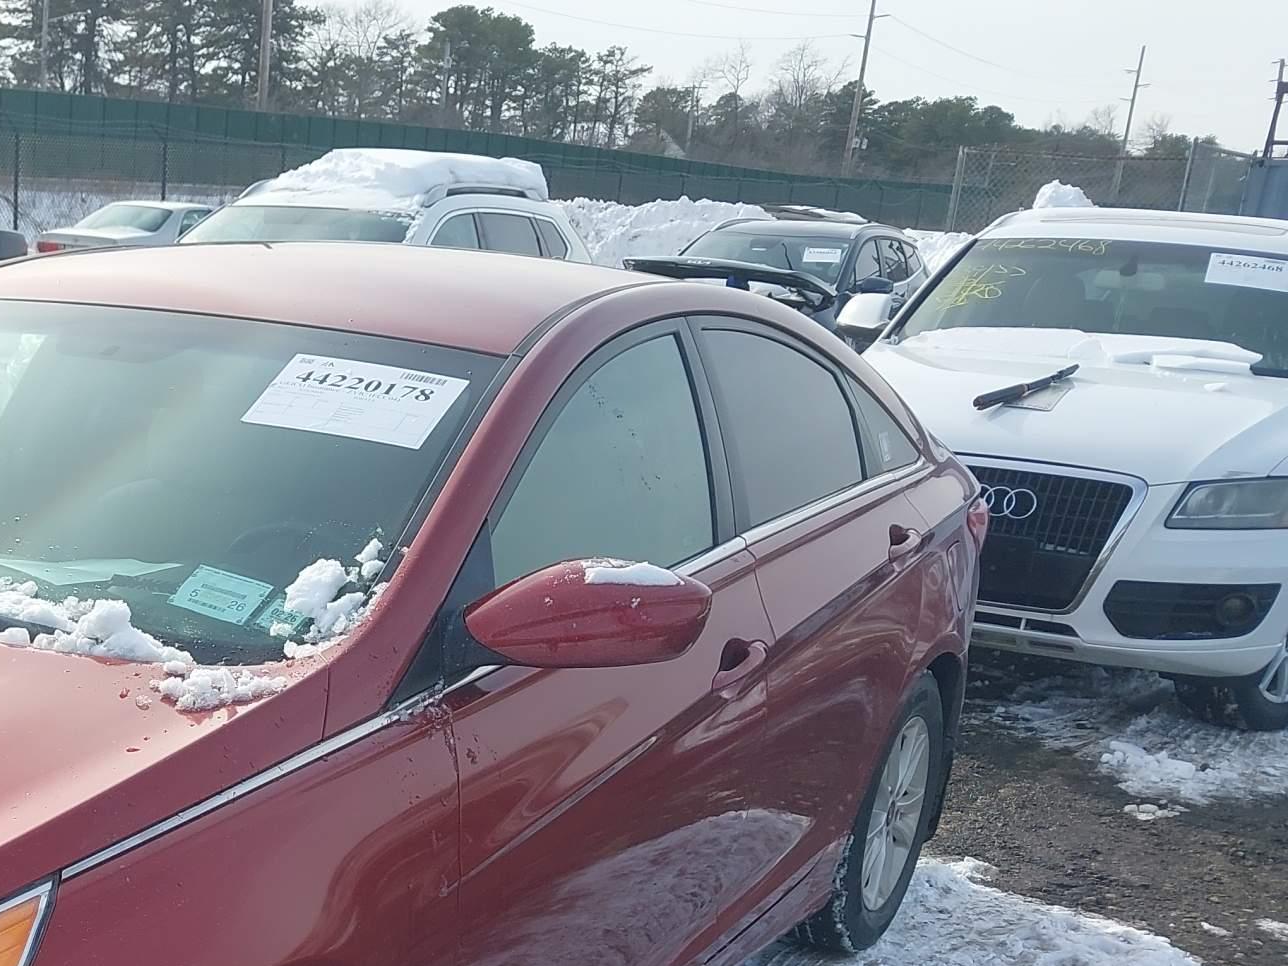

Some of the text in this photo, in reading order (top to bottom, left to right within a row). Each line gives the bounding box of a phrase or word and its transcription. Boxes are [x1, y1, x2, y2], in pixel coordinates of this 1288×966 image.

[295, 369, 436, 402] 44220178
[189, 588, 201, 598] 5
[226, 599, 247, 612] 26
